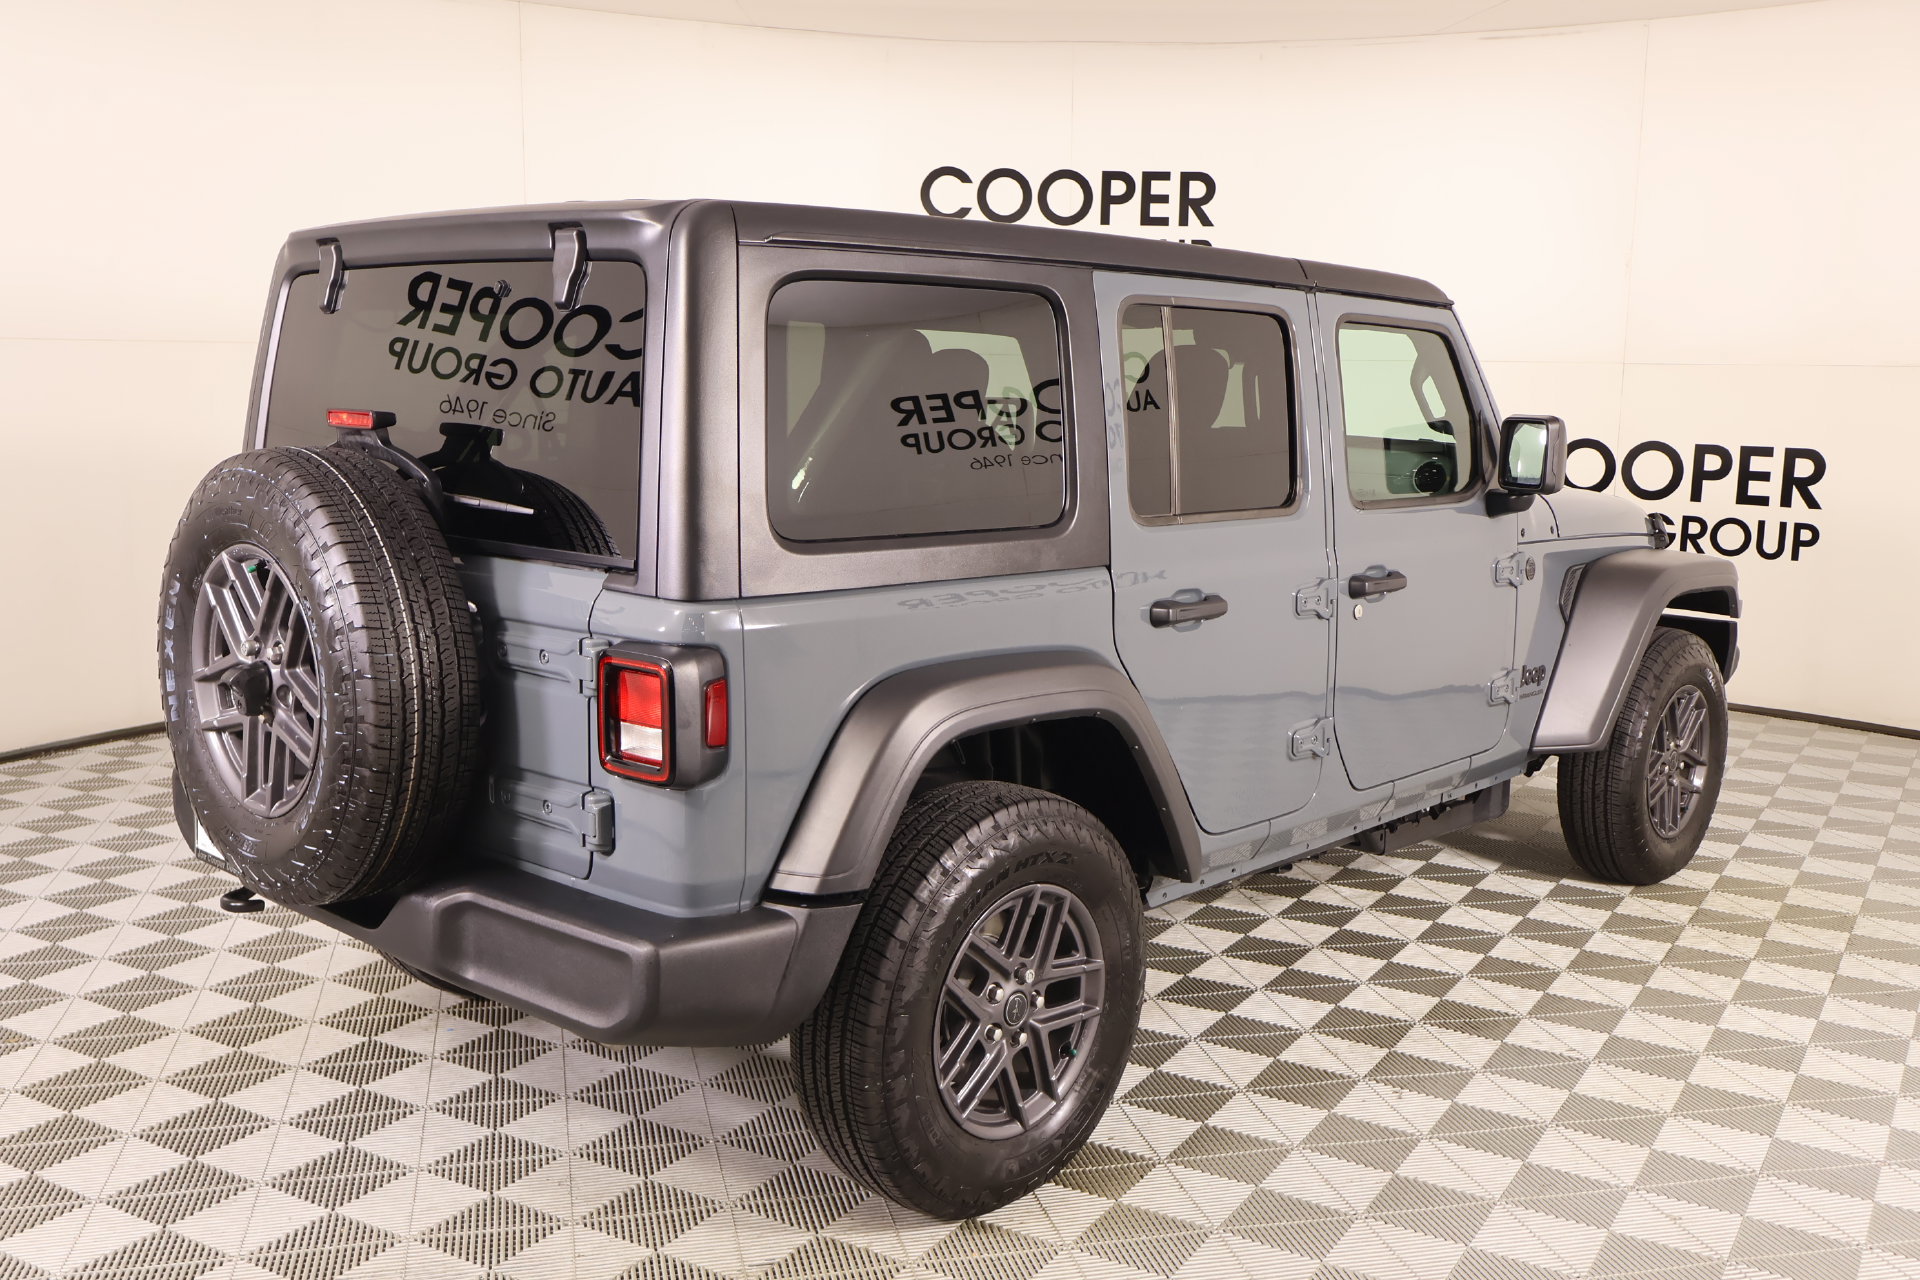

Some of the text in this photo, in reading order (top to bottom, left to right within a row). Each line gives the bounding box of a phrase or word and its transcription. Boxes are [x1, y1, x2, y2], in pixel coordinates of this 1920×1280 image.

[920, 166, 1216, 226] COOPER
[164, 579, 181, 722] NEXEN
[1520, 665, 1546, 688] Jeep
